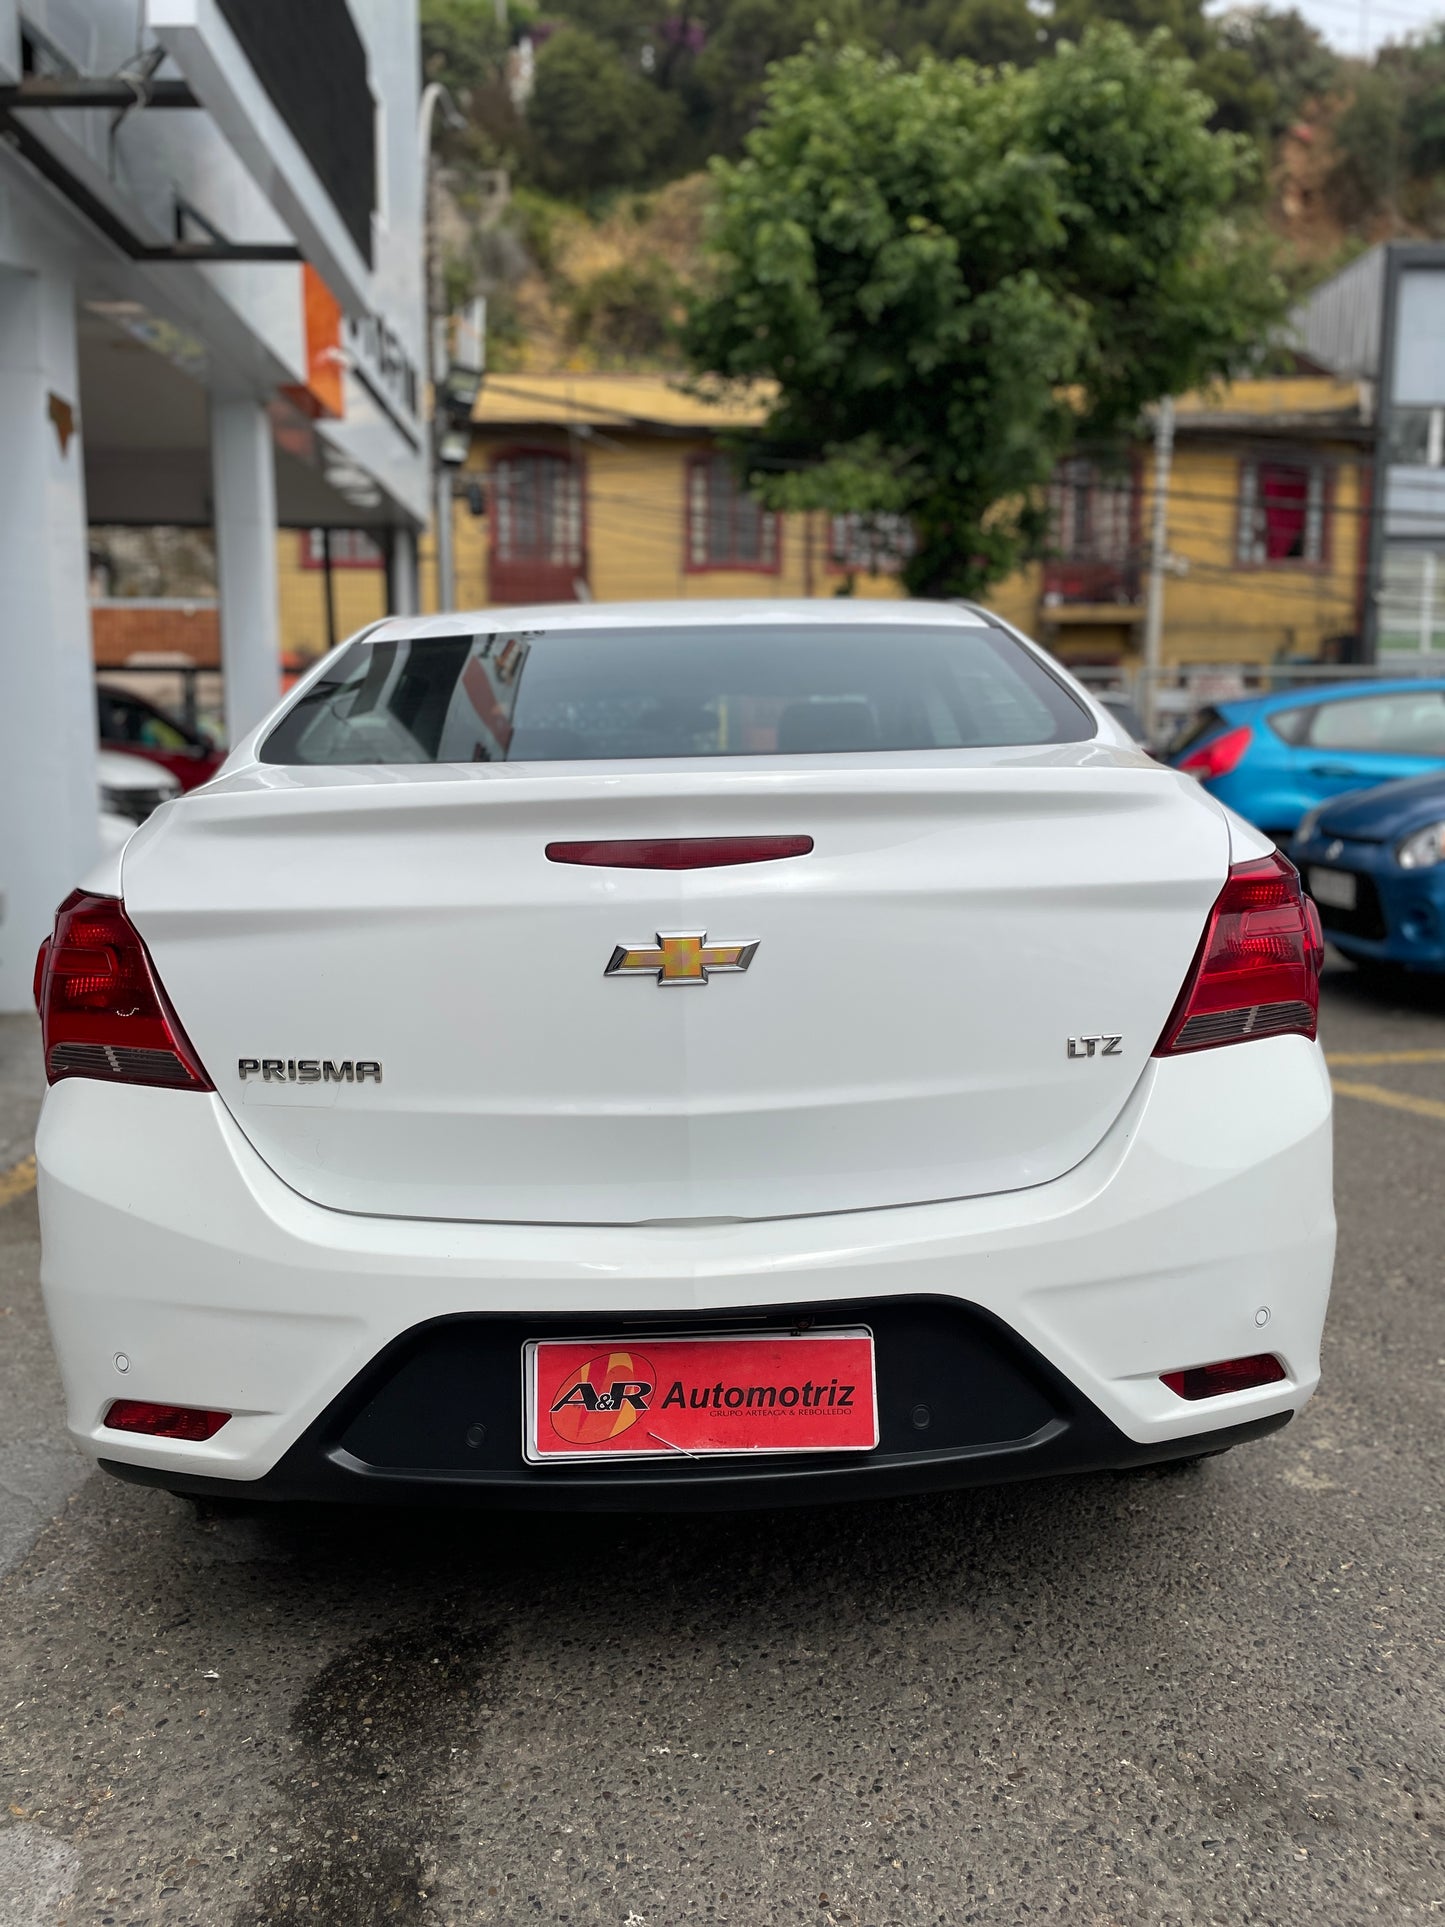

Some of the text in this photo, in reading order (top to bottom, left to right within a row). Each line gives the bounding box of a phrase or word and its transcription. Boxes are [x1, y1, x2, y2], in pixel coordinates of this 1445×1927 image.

[1067, 1033, 1123, 1059] LTZ
[238, 1058, 383, 1083] PRISMA
[549, 1379, 856, 1412] A&R Automotriz
[709, 1408, 852, 1417] GRUPO ARTEAGA & REBOLLEDO
